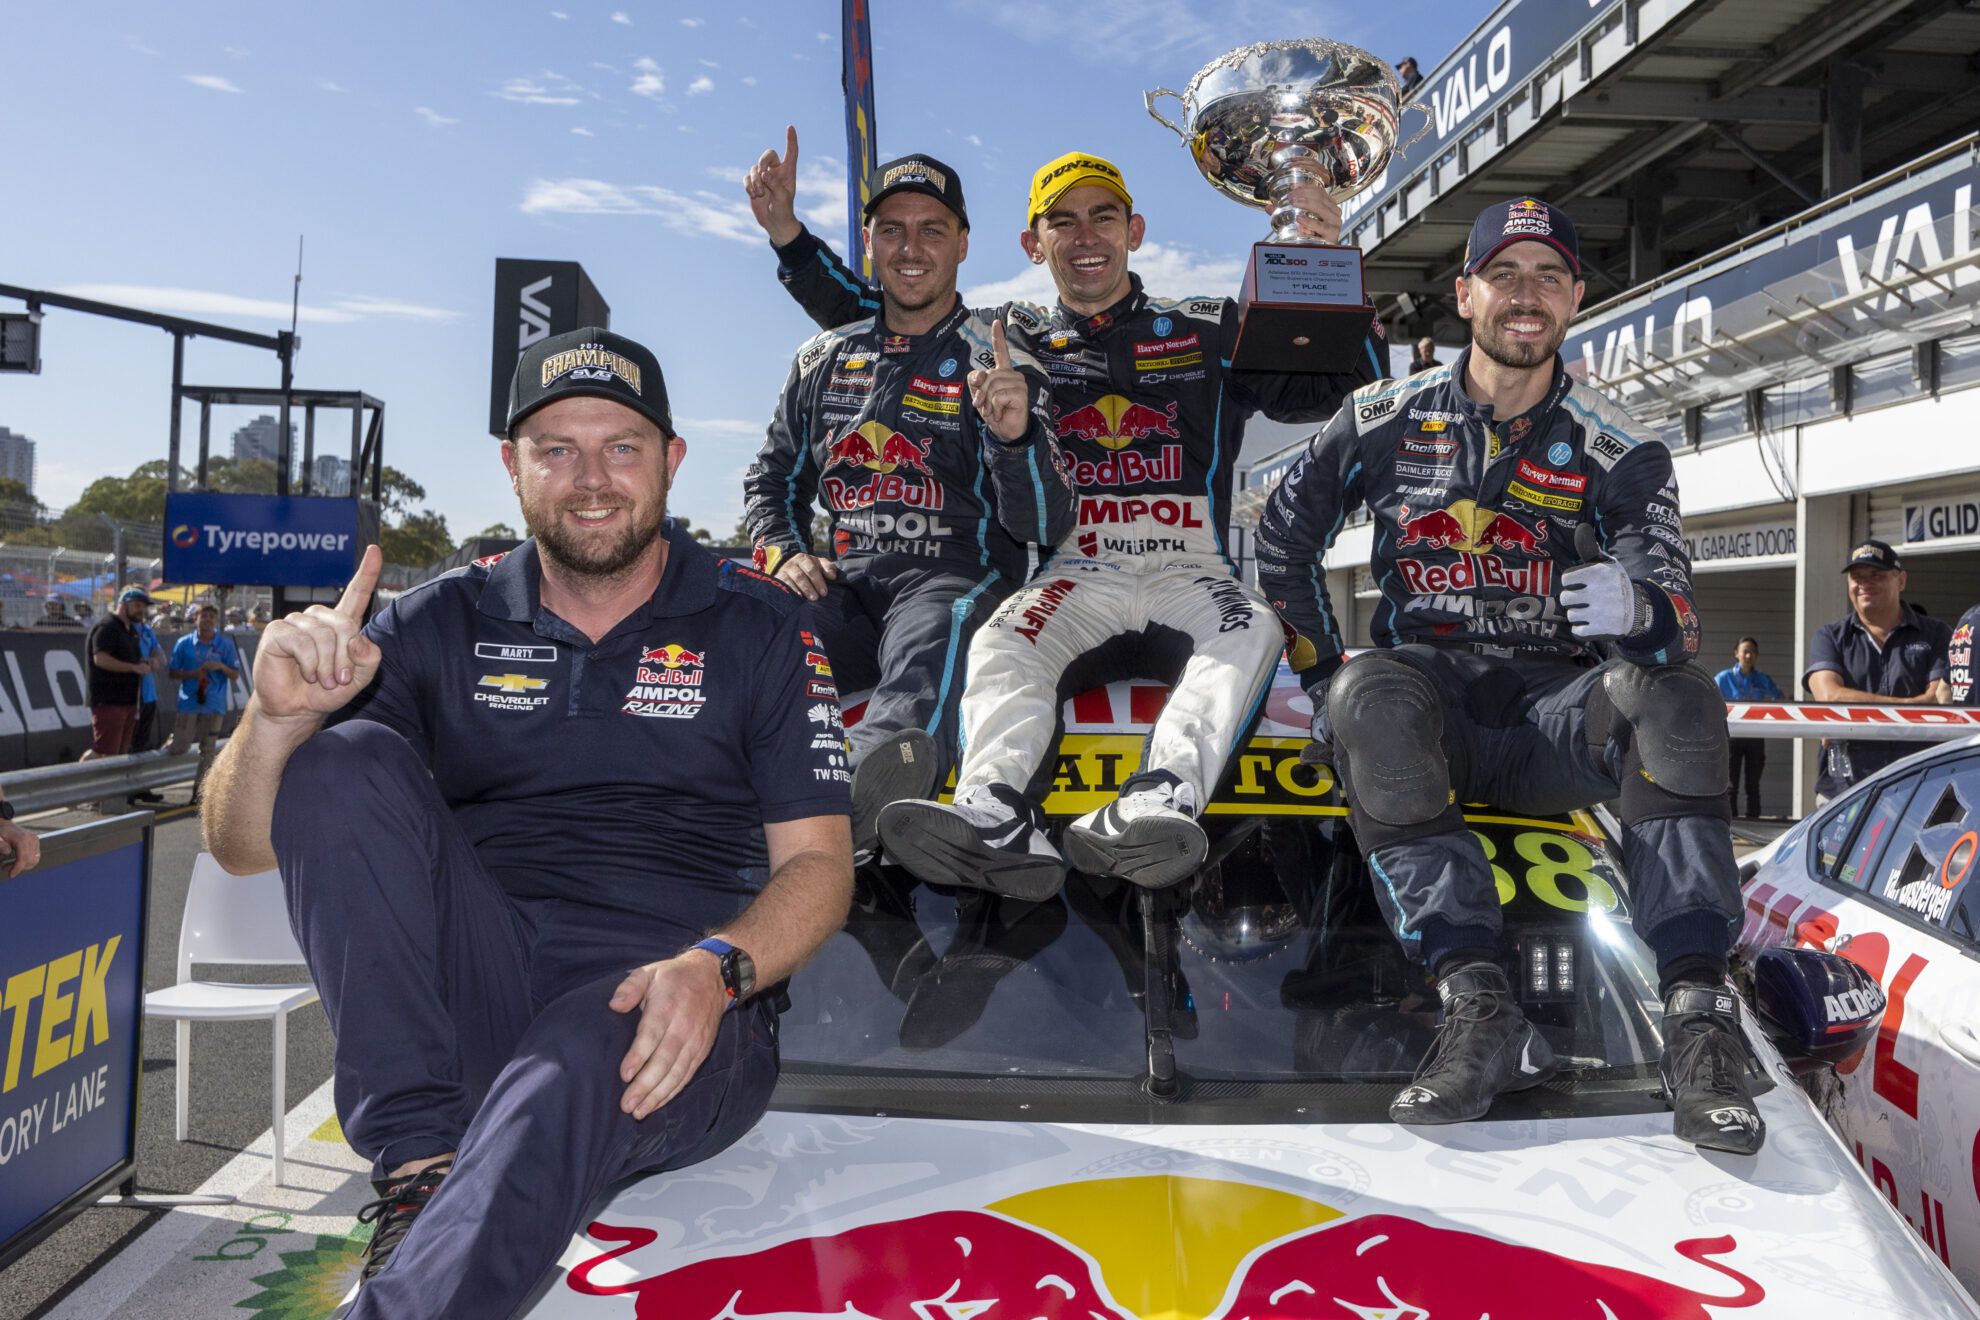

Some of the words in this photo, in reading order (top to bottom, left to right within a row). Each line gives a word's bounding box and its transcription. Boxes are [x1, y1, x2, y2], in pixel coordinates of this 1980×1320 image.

[1432, 26, 1511, 139] VALO
[1041, 160, 1118, 189] DUNLOP
[1504, 218, 1553, 231] AMPOL
[1509, 210, 1529, 219] Red
[1530, 210, 1549, 221] Bull
[1503, 225, 1552, 235] RACING
[518, 275, 552, 351] VA
[1190, 302, 1219, 313] OMP
[1157, 320, 1170, 336] hp
[802, 345, 826, 365] OMP
[1137, 343, 1165, 353] Harvey
[1165, 337, 1197, 349] Norman
[1582, 296, 1713, 398] VALO
[541, 350, 642, 396] CHAMPION
[569, 368, 613, 383] SVG
[831, 376, 872, 387] ToolPRO
[1360, 400, 1396, 421] OMP
[1404, 442, 1452, 454] ToolPRO
[1552, 443, 1570, 464] hp
[1594, 435, 1627, 461] OMP
[1120, 445, 1182, 484] Bull
[1521, 464, 1549, 483] Harvey
[1549, 474, 1582, 488] Norman
[824, 473, 882, 511] Red
[877, 475, 944, 510] Bull
[1406, 486, 1447, 497] AMPLIFY
[1511, 484, 1543, 501] NATIONAL
[1543, 497, 1578, 508] STORAGE
[1080, 499, 1202, 528] MPOL
[1929, 502, 1980, 537] GLID
[203, 525, 349, 554] Tyrepower
[1703, 532, 1751, 560] GARAGE
[1756, 527, 1797, 556] DOOR
[736, 568, 789, 595] AMPOL
[1397, 553, 1476, 595] Red
[1477, 554, 1553, 596] Bull
[500, 647, 533, 659] MARTY
[637, 667, 669, 684] Red
[671, 670, 702, 686] Bull
[473, 692, 550, 706] CHEVROLET
[625, 686, 707, 702] AMPOL
[812, 684, 836, 696] ToolP
[489, 702, 534, 711] RACING
[621, 702, 700, 717] RACING
[813, 769, 830, 781] TW
[0, 934, 122, 1093] TEK
[1715, 998, 1732, 1009] OMP
[52, 1064, 109, 1131] LANE
[1711, 1110, 1759, 1136] OMP
